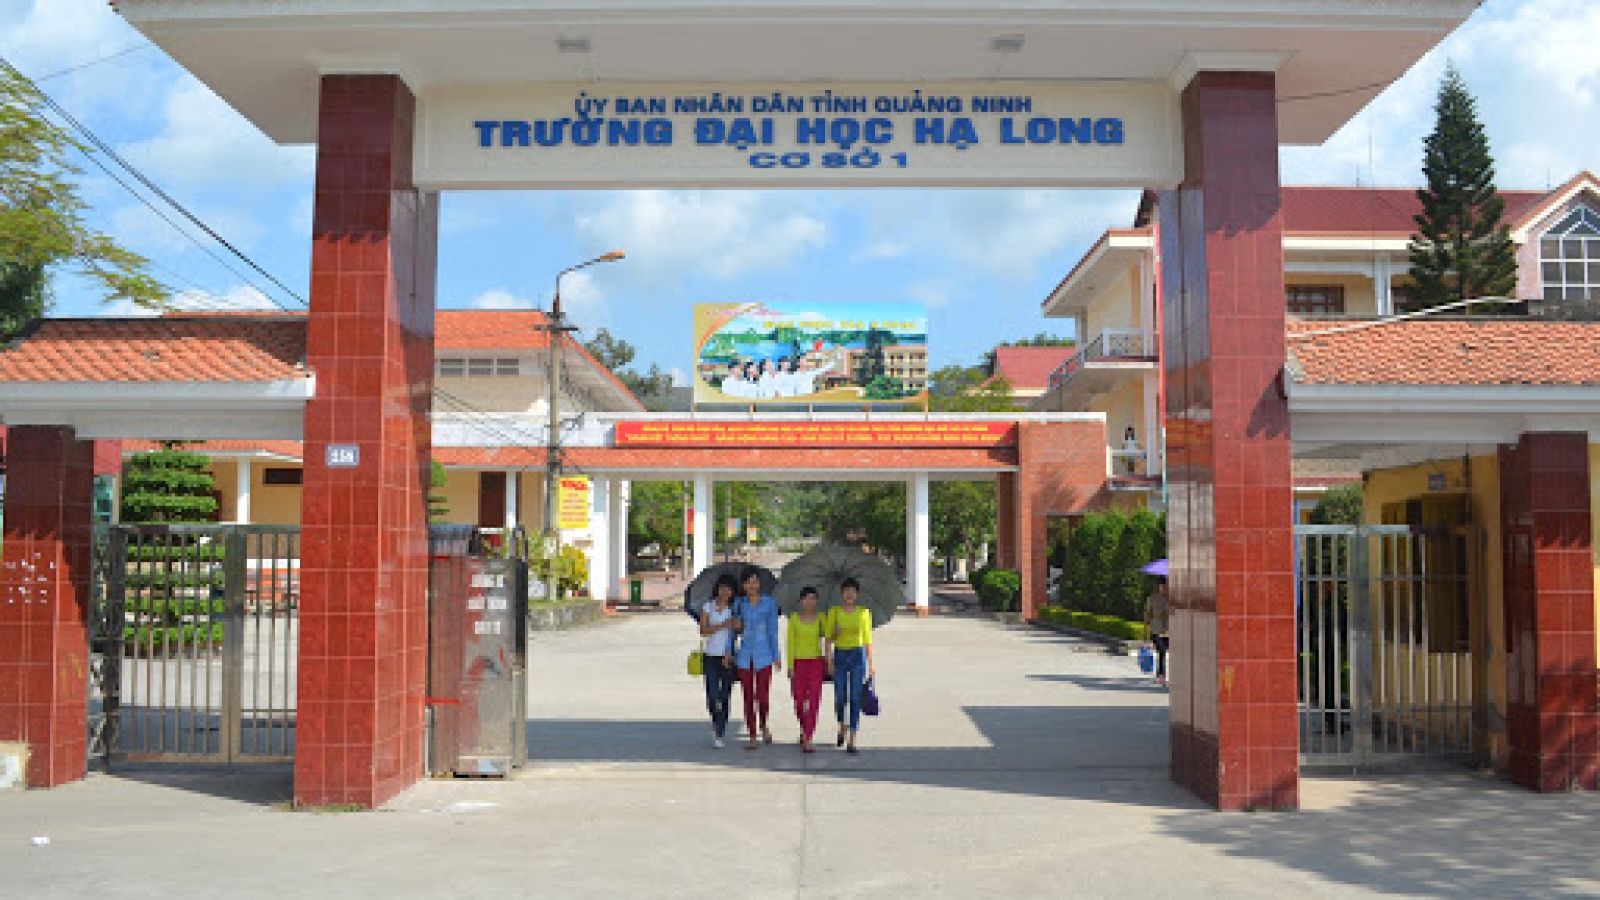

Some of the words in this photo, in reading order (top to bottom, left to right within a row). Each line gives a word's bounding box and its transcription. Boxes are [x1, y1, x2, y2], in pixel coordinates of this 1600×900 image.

[574, 91, 609, 116] ỦY
[615, 97, 667, 115] BAN
[674, 92, 745, 115] NHÂN
[752, 92, 804, 115] DÂN
[810, 90, 867, 113] TỈNH
[874, 90, 963, 113] QUẢNG
[971, 96, 1032, 113] NINH
[474, 112, 673, 147] TRƯỜNG
[693, 116, 776, 152] ĐẠI
[796, 116, 894, 150] HỌC
[914, 116, 979, 150] HẠ
[999, 116, 1125, 145] LONG
[748, 152, 812, 169] CƠ
[821, 147, 882, 169] SỞ
[890, 152, 908, 168] 1
